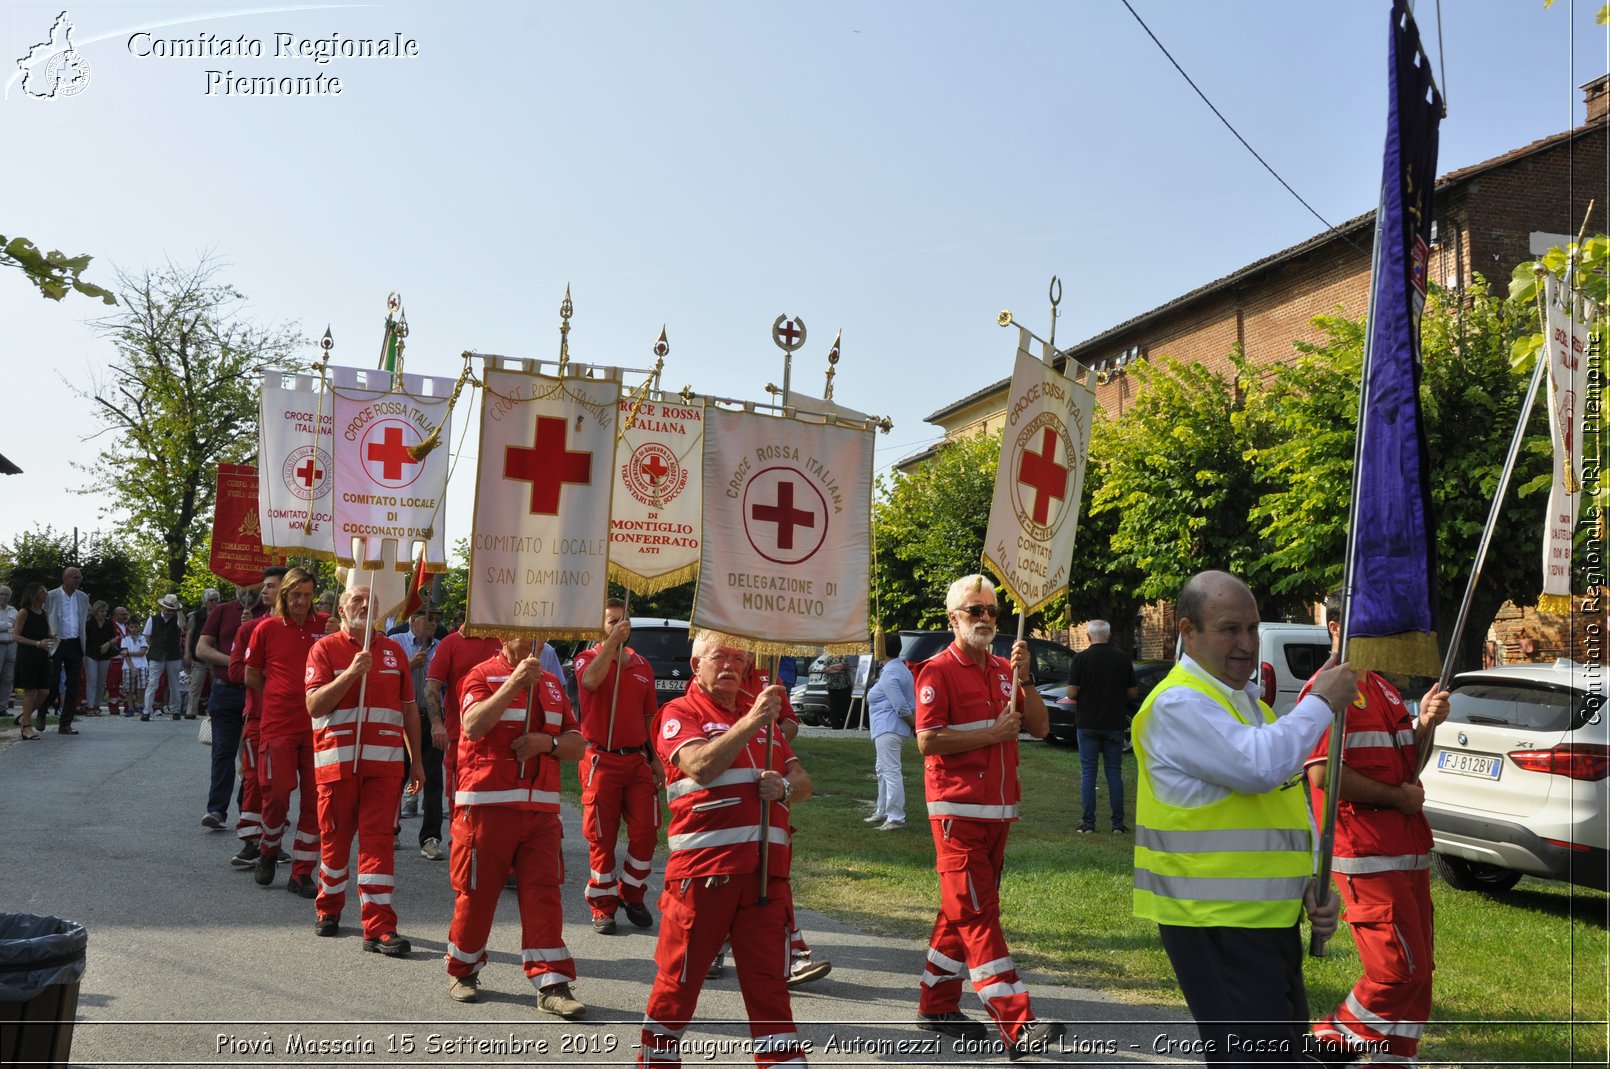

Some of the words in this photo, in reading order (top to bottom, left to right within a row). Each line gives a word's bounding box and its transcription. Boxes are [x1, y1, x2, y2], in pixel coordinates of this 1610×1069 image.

[490, 386, 521, 421] CROCE
[532, 384, 565, 402] ROSSA
[571, 387, 613, 430] ITALIANA
[620, 401, 655, 416] ROCE
[662, 407, 701, 420] ROSSA
[1010, 384, 1040, 426] CROCE
[285, 411, 313, 422] CROCE
[317, 415, 333, 424] ROS
[344, 407, 374, 441] CROCE
[374, 402, 407, 417] ROSSA
[408, 407, 443, 449] ITALIAA
[621, 464, 647, 505] VOLONTARI
[663, 468, 688, 504] SOCCORSO
[726, 456, 751, 499] CROCE
[756, 445, 799, 462] ROSSA
[805, 456, 843, 515] ITALIANA
[343, 493, 397, 506] COMITATO
[400, 498, 435, 508] LOCALE
[268, 509, 307, 519] COMITATO
[312, 512, 333, 522] LOCA
[387, 512, 397, 521] DI
[289, 521, 319, 531] MONLE
[343, 523, 405, 537] COCCONATO
[407, 527, 434, 538] D'ASI
[611, 520, 693, 534] MONTIGLIO
[475, 534, 542, 553] COMITATO
[553, 539, 606, 556] LOCALE
[1017, 536, 1052, 560] COMITATO
[234, 563, 265, 572] COCCONA
[486, 567, 516, 585] SAN
[526, 570, 590, 587] DAMIANO
[997, 540, 1039, 599] VILLANOVA
[1018, 557, 1047, 578] LOCALE
[728, 572, 813, 595] DELEGAZIONE
[826, 582, 837, 597] DI
[513, 600, 554, 617] D'ASTI
[743, 593, 824, 616] MONCALVO
[669, 680, 684, 689] 524
[1516, 740, 1534, 748] X1
